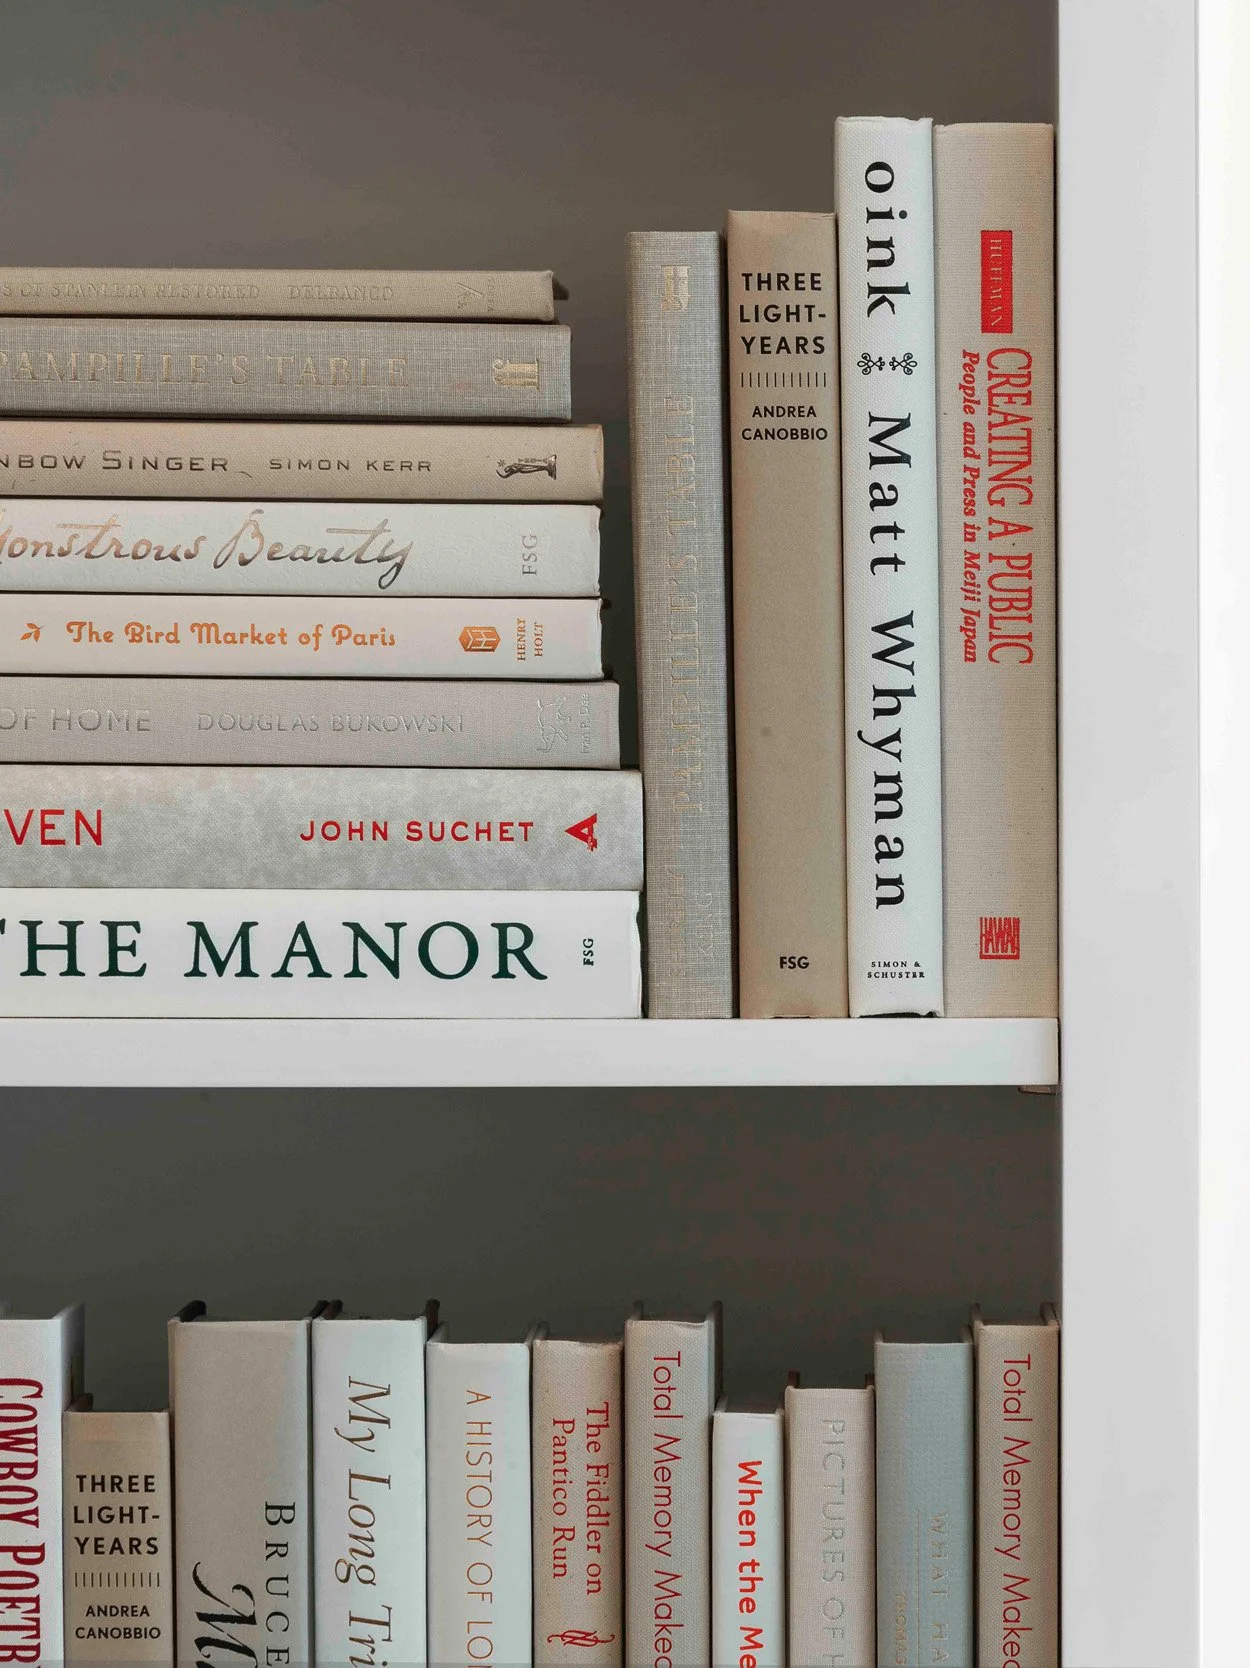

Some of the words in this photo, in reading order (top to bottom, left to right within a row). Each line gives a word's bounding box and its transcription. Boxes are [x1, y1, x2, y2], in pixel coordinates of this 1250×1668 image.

[865, 161, 912, 318] oink
[20, 283, 45, 297] OF
[287, 285, 394, 300] DELBANCO
[741, 271, 822, 292] THREE
[989, 238, 1006, 326] HUFFMAN
[740, 304, 827, 324] LIGHT-
[740, 335, 825, 355] YEARS
[267, 356, 409, 388] TABLE
[959, 349, 981, 415] People
[742, 427, 828, 441] CANOBBIO
[752, 406, 817, 418] ANDREA
[984, 348, 1033, 507] CREATING
[962, 421, 981, 460] and
[270, 459, 349, 470] SIMON
[367, 460, 431, 471] KERR
[664, 397, 697, 536] TABLE
[868, 411, 912, 576] Matt
[962, 464, 981, 516] Press
[212, 506, 416, 592] Beauty
[964, 522, 981, 542] in
[987, 517, 1033, 540] A
[522, 535, 537, 575] FSG
[960, 550, 981, 602] Meiji
[984, 553, 1033, 664] PUBLIC
[66, 621, 114, 643] The
[125, 622, 180, 644] Bird
[190, 623, 287, 645] Market
[298, 624, 323, 651] of
[331, 624, 395, 646] Paris
[517, 619, 525, 661] HENRY
[534, 625, 543, 657] HOLT
[960, 608, 980, 663] Japan
[0, 709, 37, 731] OF
[52, 708, 152, 733] HOME
[198, 712, 319, 733] DOUGLAS
[331, 714, 466, 735] BUKOWSKI
[857, 610, 917, 909] Whyman
[3, 807, 102, 846] VEN
[300, 821, 388, 842] JOHN
[405, 821, 533, 843] SUCHET
[0, 918, 147, 977] HE
[184, 921, 548, 980] MANOR
[583, 938, 594, 966] FSG
[780, 956, 809, 969] FSG
[466, 1390, 491, 1405] A
[652, 1351, 683, 1418] Total
[1003, 1354, 1033, 1422] Total
[334, 1376, 390, 1452] My
[585, 1401, 610, 1453] The
[0, 1378, 44, 1528] COWBOY
[552, 1418, 575, 1516] Pantico
[76, 1474, 156, 1494] THREE
[466, 1422, 492, 1546] HISTORY
[585, 1461, 610, 1551] Fiddler
[645, 1433, 682, 1557] Memory
[738, 1461, 763, 1546] When
[820, 1418, 846, 1585] PICTURES
[993, 1437, 1031, 1560] Memory
[74, 1505, 160, 1524] LIGHT-
[335, 1469, 391, 1586] Long
[74, 1536, 160, 1556] YEARS
[553, 1526, 575, 1579] Run
[931, 1511, 950, 1599] WHAT
[265, 1501, 295, 1666] BRUCE
[467, 1563, 492, 1603] OF
[586, 1559, 602, 1595] on
[738, 1559, 763, 1613] the
[0, 1543, 46, 1668] POETR
[85, 1605, 150, 1617] ANDREA
[822, 1597, 844, 1640] OF
[75, 1626, 162, 1640] CANOBBIO
[467, 1621, 493, 1668] LO
[739, 1626, 763, 1668] Me
